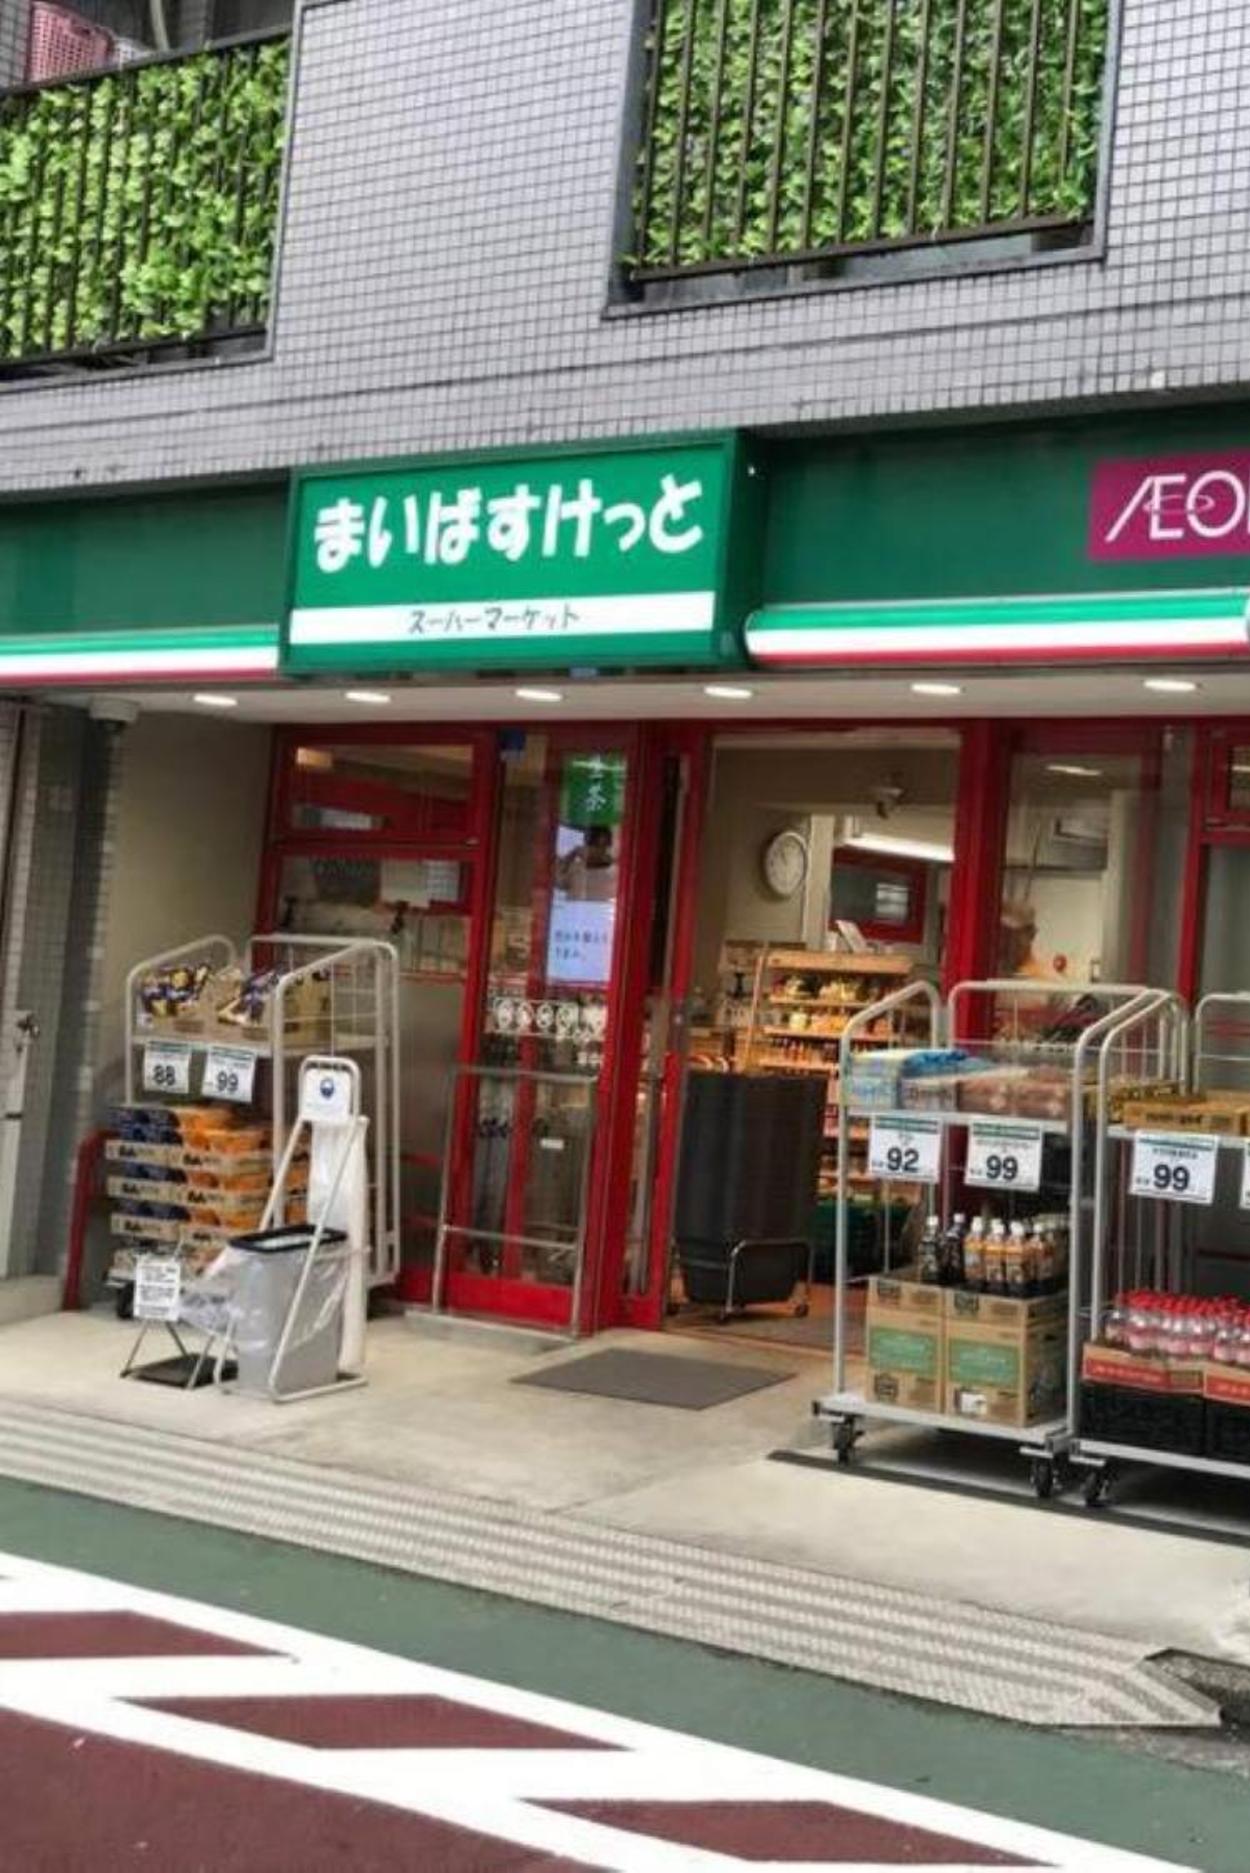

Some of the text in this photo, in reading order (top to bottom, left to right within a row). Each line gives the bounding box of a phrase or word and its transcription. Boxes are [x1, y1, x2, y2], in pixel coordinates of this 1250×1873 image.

[314, 473, 703, 573] まいばすけっと
[153, 1064, 176, 1087] 88
[215, 1070, 239, 1094] 99
[887, 1146, 920, 1173] 92
[985, 1154, 1018, 1181] 99
[1153, 1163, 1190, 1192] 99
